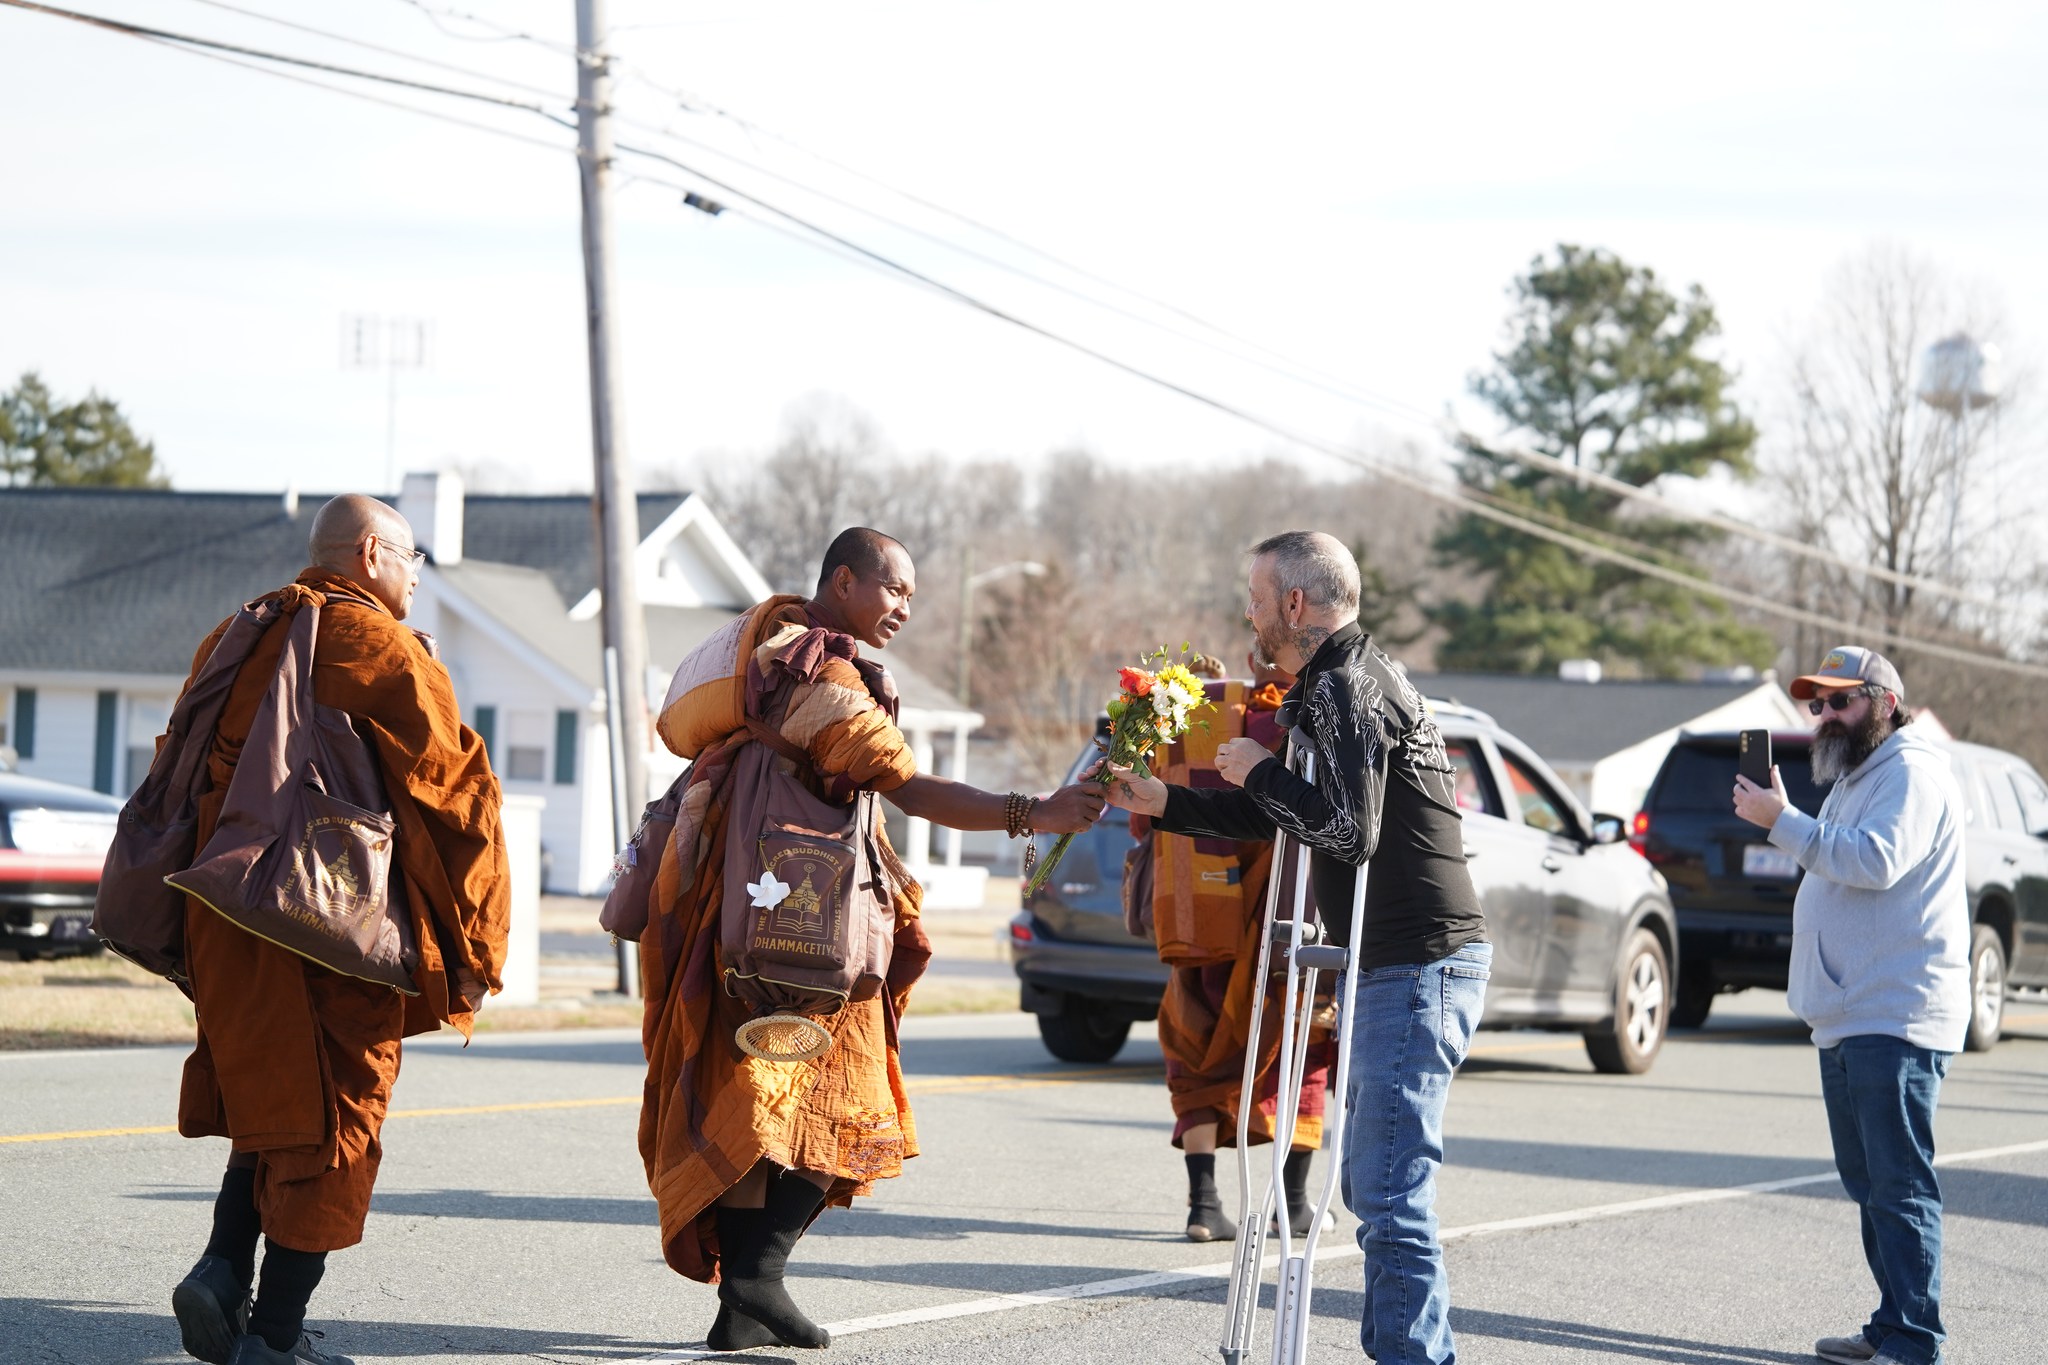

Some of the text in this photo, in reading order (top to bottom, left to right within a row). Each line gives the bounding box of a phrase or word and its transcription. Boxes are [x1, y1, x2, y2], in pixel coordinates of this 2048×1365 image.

[791, 847, 840, 866] BUDDHIST
[833, 909, 842, 942] STUPAS
[757, 915, 766, 932] THE
